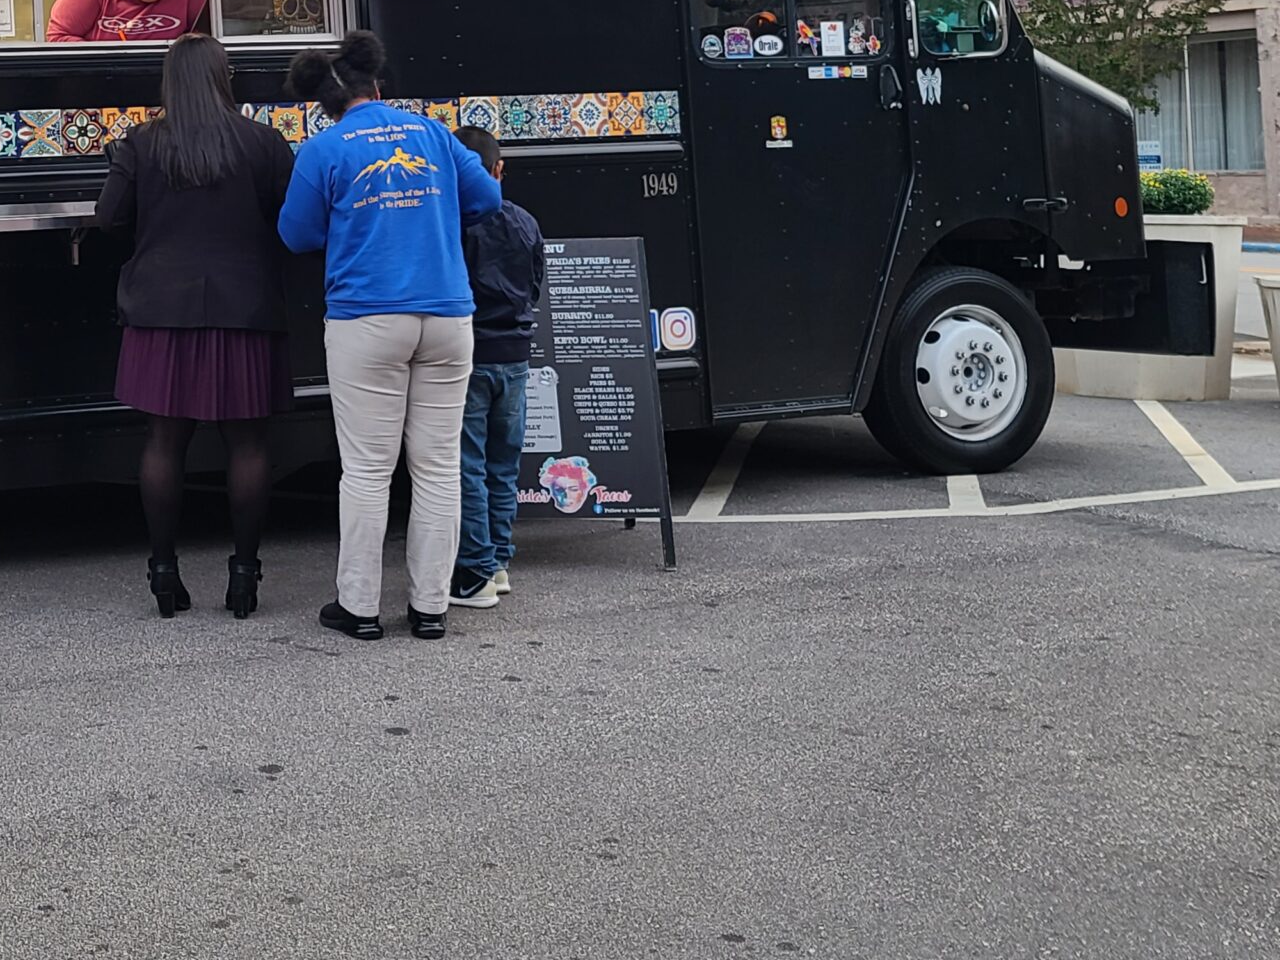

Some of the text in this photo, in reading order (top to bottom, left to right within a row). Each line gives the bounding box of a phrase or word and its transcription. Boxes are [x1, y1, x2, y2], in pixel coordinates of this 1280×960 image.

[103, 17, 165, 29] OBX
[641, 172, 678, 198] 1949
[543, 244, 566, 254] NU
[546, 257, 583, 266] FRIDA'S
[583, 257, 610, 265] FRIES
[548, 286, 613, 296] QUESABIRRIA
[551, 312, 593, 320] BURRITO
[553, 336, 579, 345] KETO
[580, 336, 608, 344] BOWL
[517, 485, 632, 505] rida's Tacos
